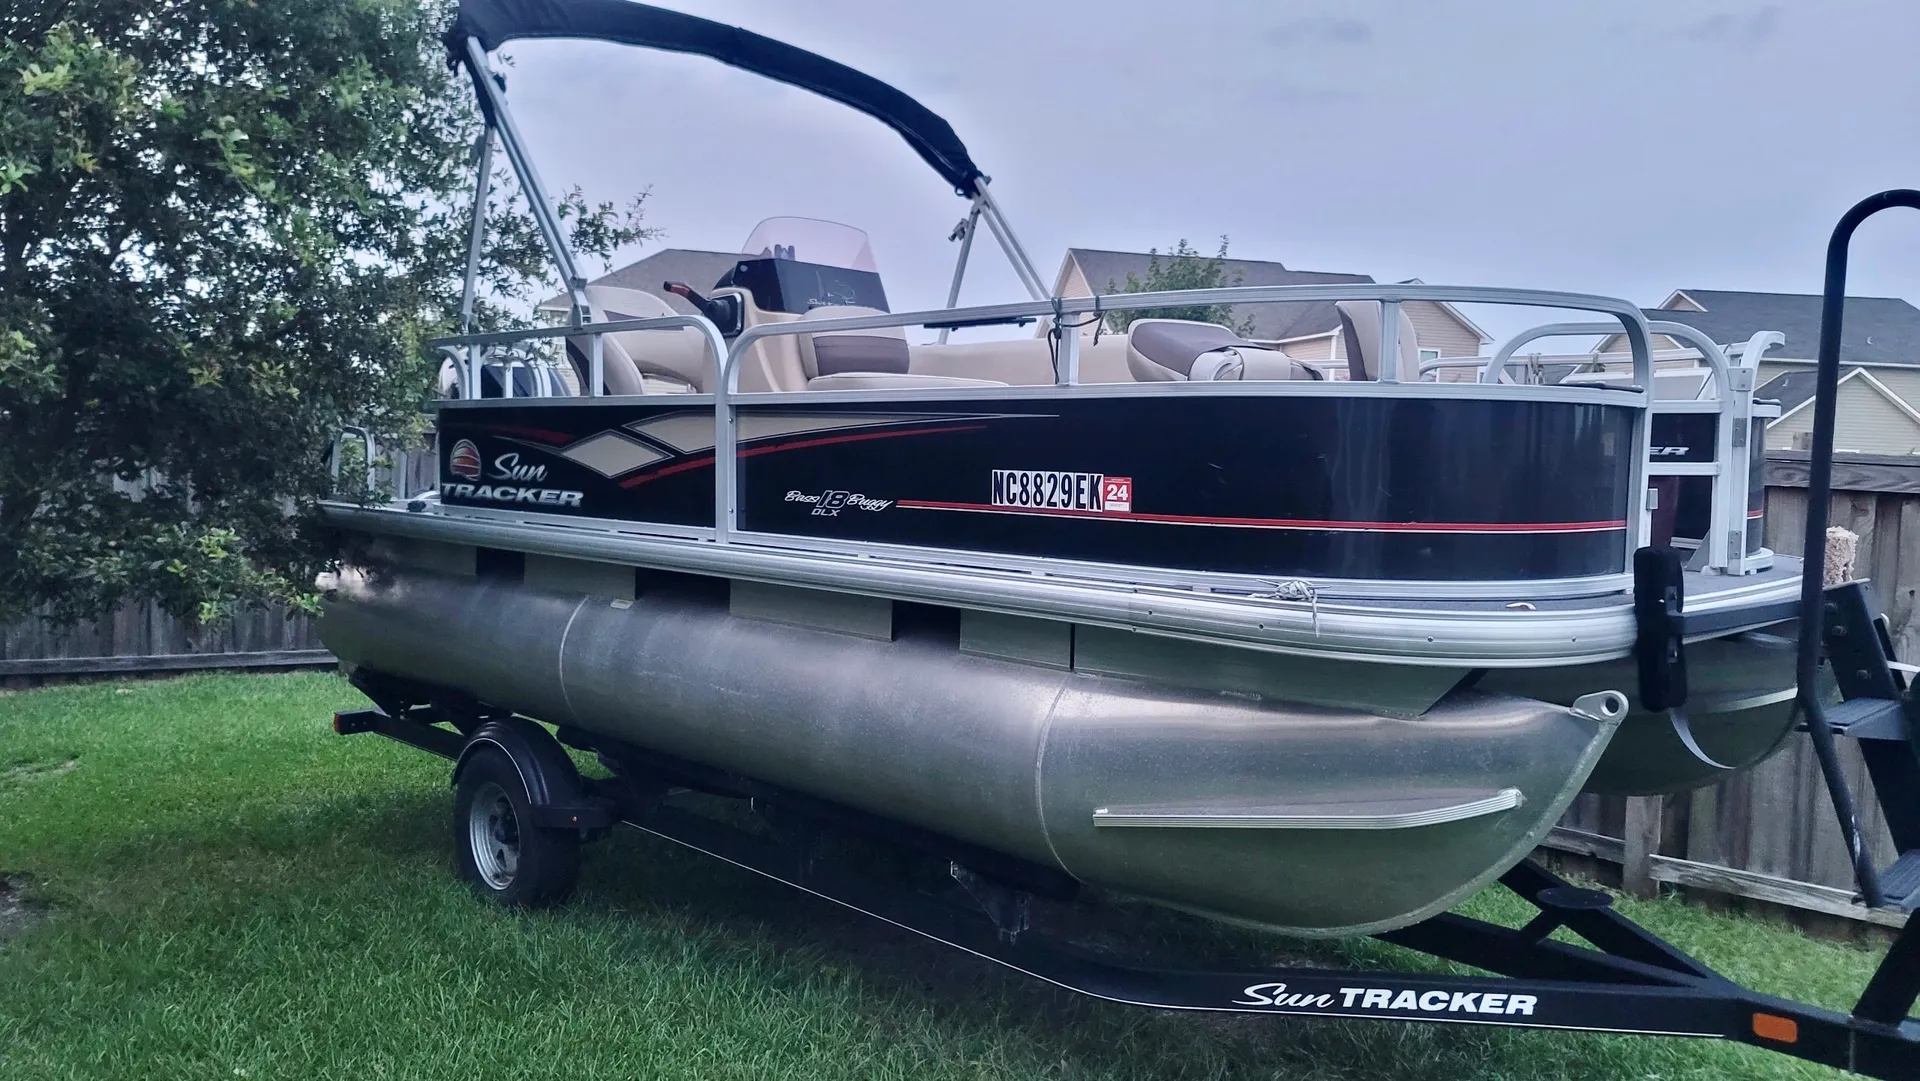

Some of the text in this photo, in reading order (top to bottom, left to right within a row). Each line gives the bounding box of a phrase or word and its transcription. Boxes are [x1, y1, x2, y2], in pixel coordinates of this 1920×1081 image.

[486, 452, 549, 482] Sun
[441, 482, 584, 508] TRACKER
[784, 489, 894, 512] Bass 18 Buggy
[993, 470, 1103, 511] NC8829EK
[1105, 481, 1129, 501] 24
[811, 508, 840, 517] DLX
[1232, 982, 1538, 1016] Sun TRACKER
